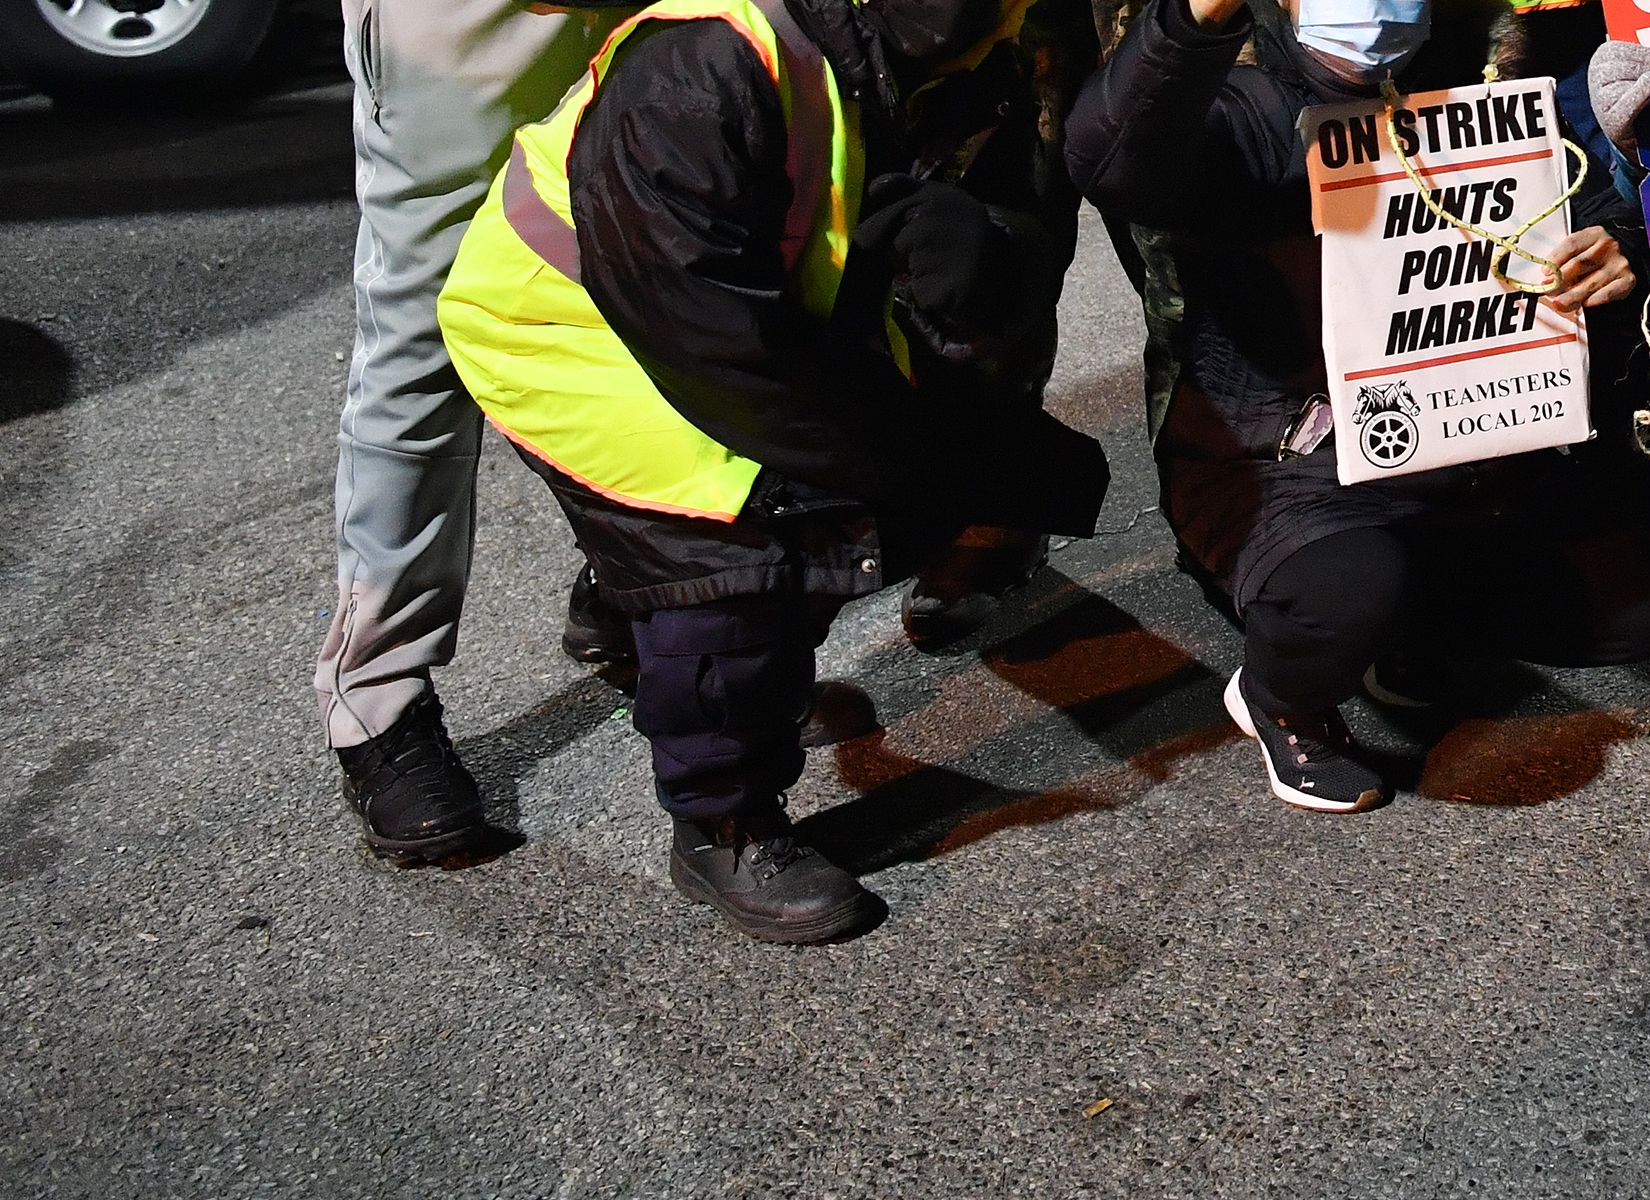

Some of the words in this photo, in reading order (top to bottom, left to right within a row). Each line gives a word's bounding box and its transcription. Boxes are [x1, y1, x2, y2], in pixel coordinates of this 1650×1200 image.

[1318, 113, 1381, 170] ON
[1394, 91, 1548, 159] STRIKE
[1382, 177, 1517, 240] HUNTS
[1397, 234, 1520, 296] POINT
[1384, 291, 1540, 357] MARKET
[1426, 367, 1573, 411] TEAMSTERS
[1442, 408, 1526, 440] LOCAL
[1529, 400, 1566, 425] 202
